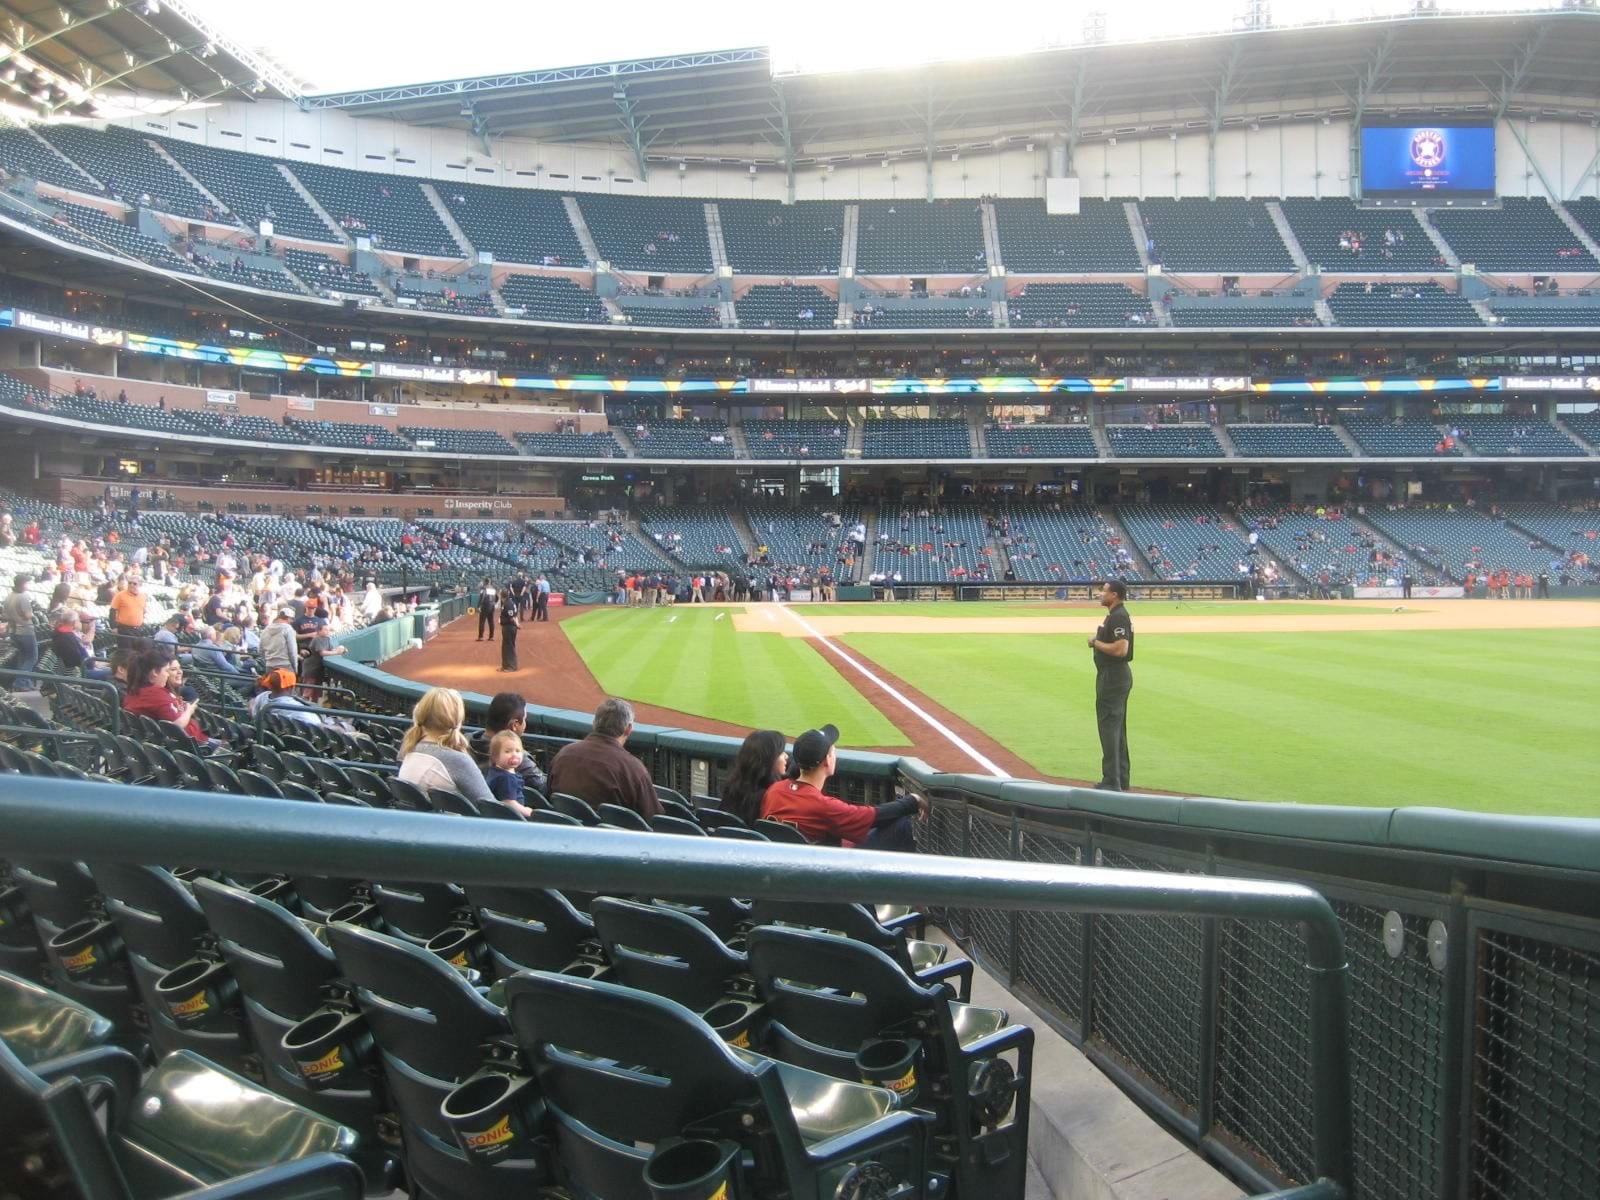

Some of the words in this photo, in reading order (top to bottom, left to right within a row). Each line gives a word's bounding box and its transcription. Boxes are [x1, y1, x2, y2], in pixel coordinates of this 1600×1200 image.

[19, 311, 60, 333] Minute
[61, 322, 89, 339] Maid
[379, 363, 422, 378] Minute
[423, 368, 454, 381] Maid
[754, 380, 798, 391] Minute
[798, 380, 830, 392] Maid
[1131, 378, 1176, 389] Minute
[1176, 378, 1208, 390] Maid
[1506, 378, 1550, 389] Minute
[1551, 377, 1582, 389] Maid
[455, 500, 493, 510] Insperity
[494, 500, 512, 509] Club
[63, 952, 93, 969] SONIC
[171, 998, 205, 1015] SONIC
[303, 1054, 341, 1073] SONIC
[888, 1075, 916, 1090] SONIC
[468, 1122, 511, 1145] SONIC
